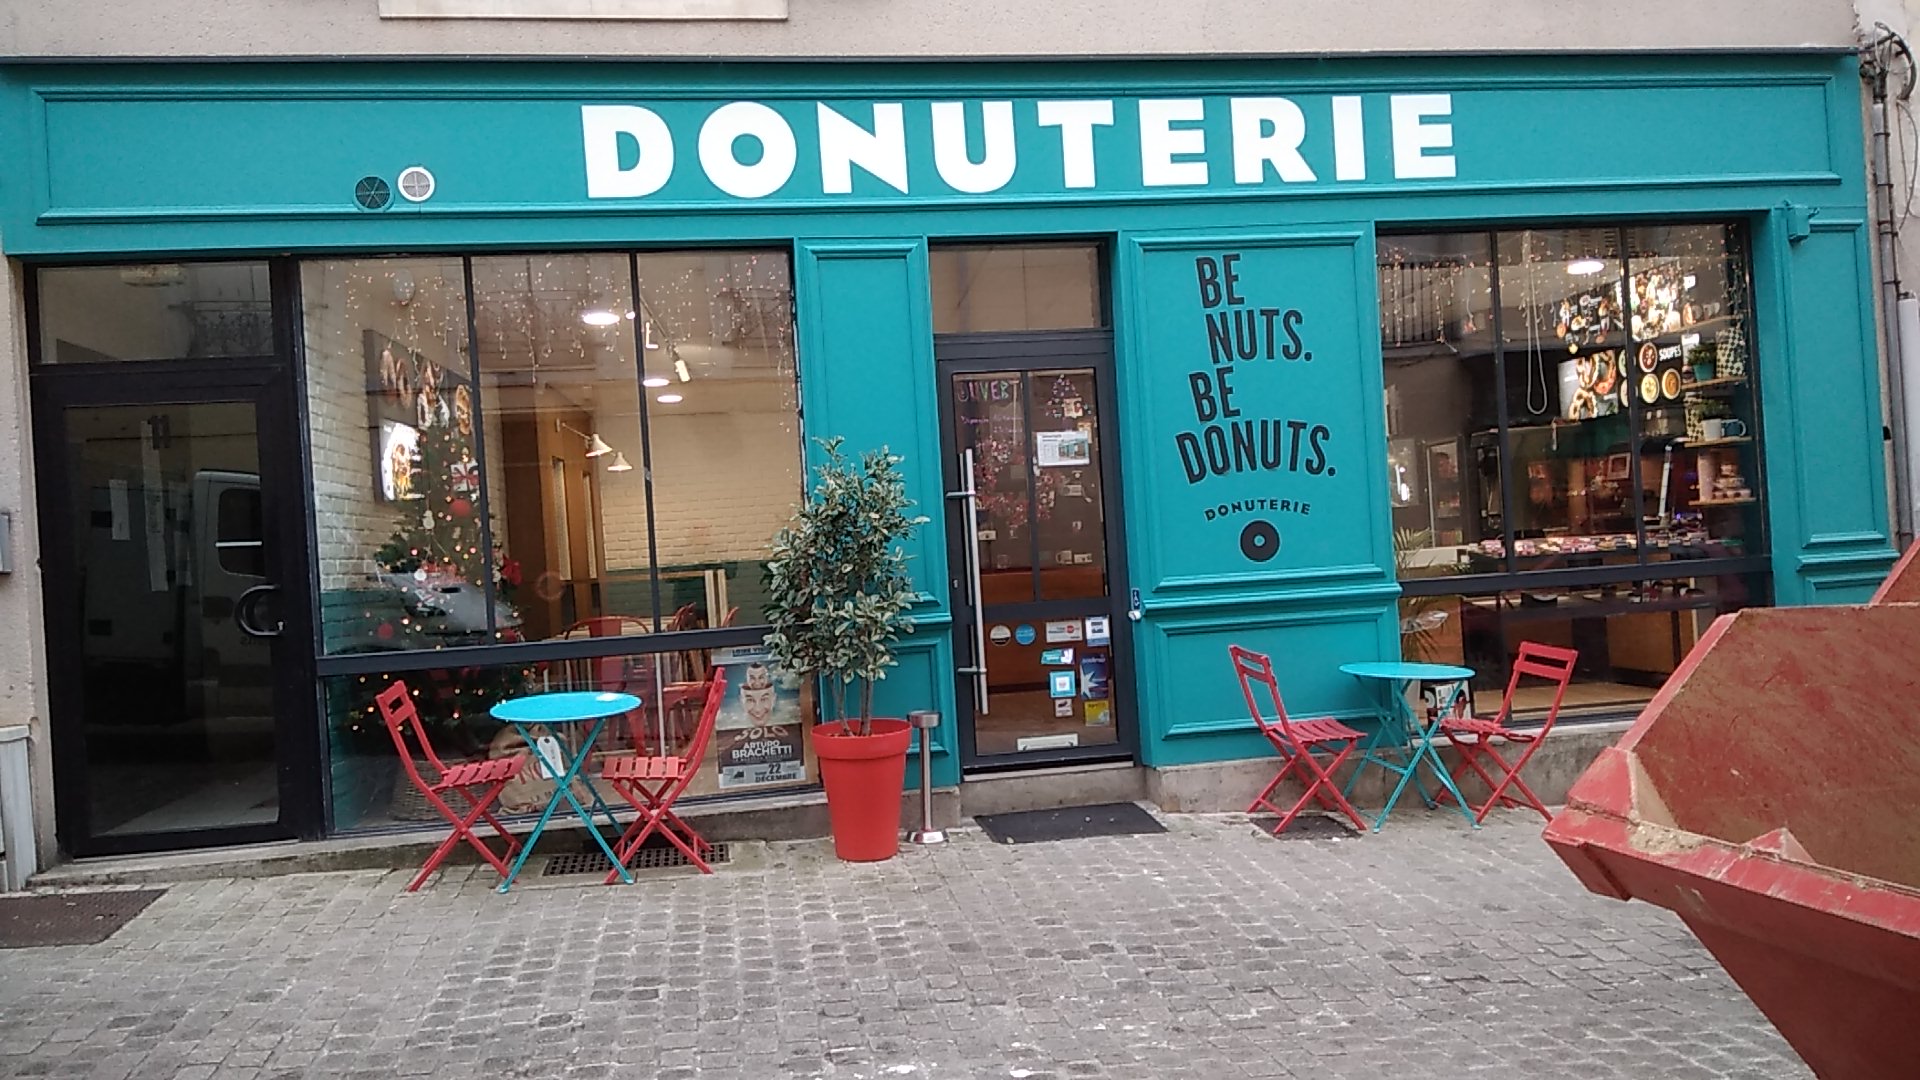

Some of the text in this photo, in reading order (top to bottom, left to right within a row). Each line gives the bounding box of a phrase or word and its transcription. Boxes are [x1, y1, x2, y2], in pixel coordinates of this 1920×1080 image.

[581, 95, 1456, 198] DONUTERIE
[1196, 254, 1245, 308] BE
[1205, 309, 1312, 364] NUTS.
[1189, 366, 1241, 423] BE
[1175, 419, 1336, 485] DONUTS.
[1204, 499, 1311, 521] DONUTERIE
[732, 745, 792, 759] BRACHETTI
[734, 726, 789, 741] SOLO
[743, 740, 781, 749] ARTURO
[768, 763, 782, 775] 22
